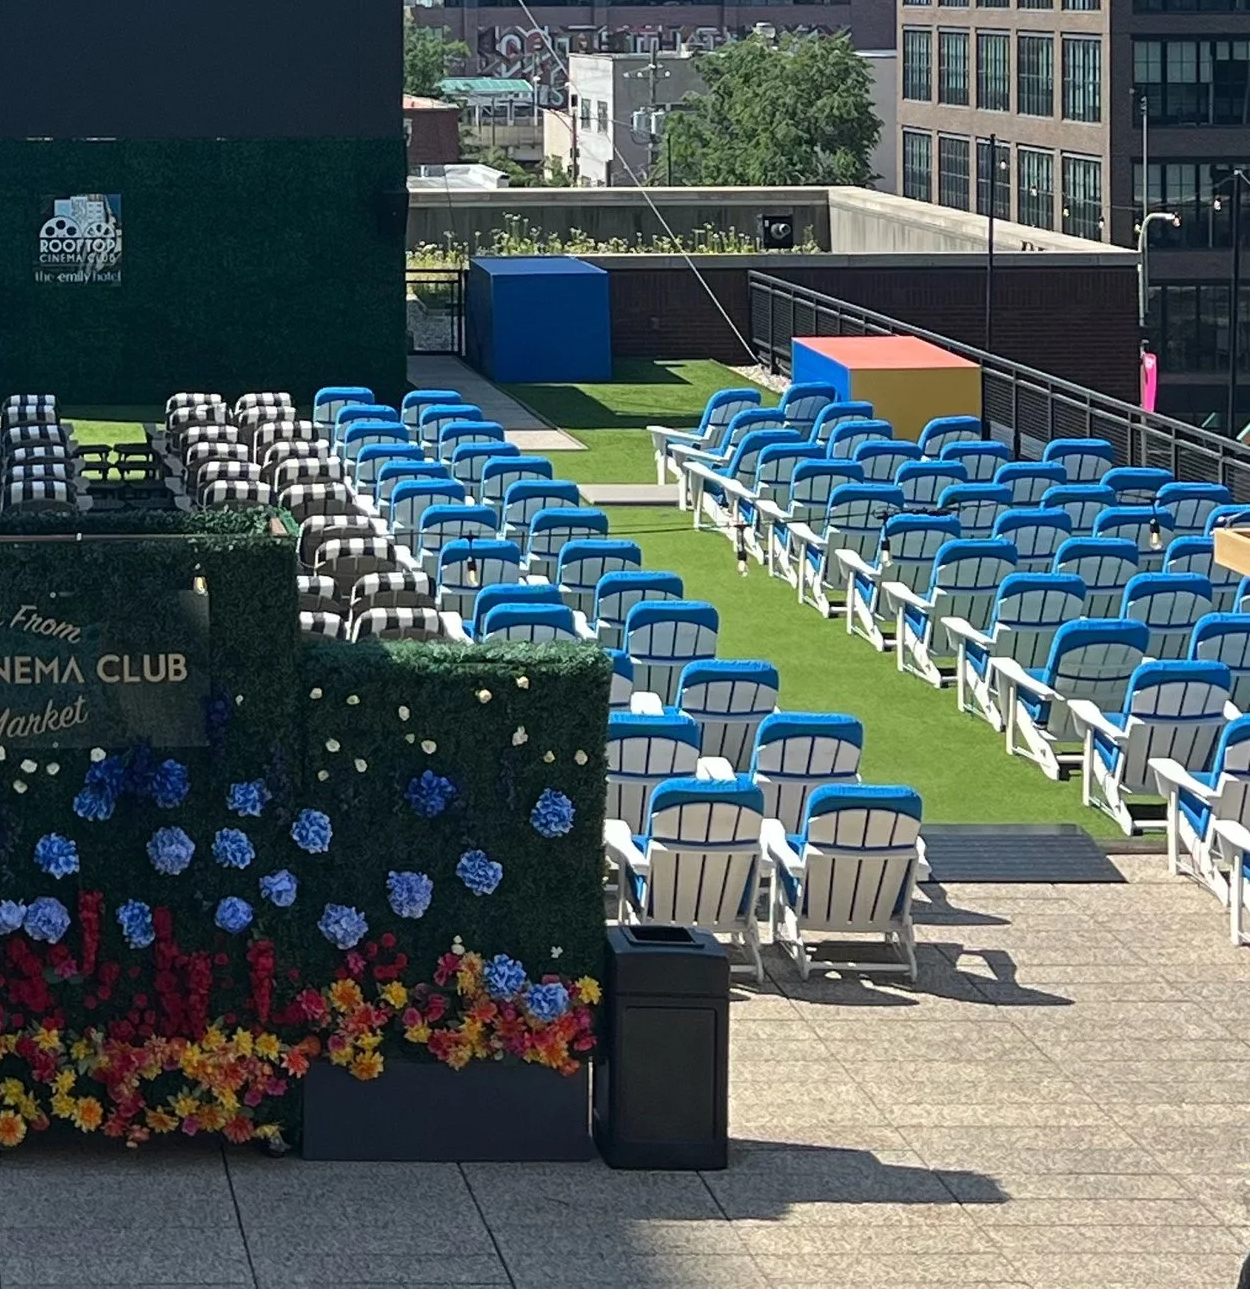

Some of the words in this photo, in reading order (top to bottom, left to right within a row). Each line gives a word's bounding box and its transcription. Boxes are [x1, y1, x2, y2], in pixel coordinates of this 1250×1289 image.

[39, 239, 116, 253] ROOFTOP
[39, 253, 83, 264] CINEMA
[34, 271, 53, 282] the
[57, 270, 91, 285] emily
[92, 270, 122, 282] hotel
[9, 604, 82, 644] From
[96, 653, 188, 683] CLUB
